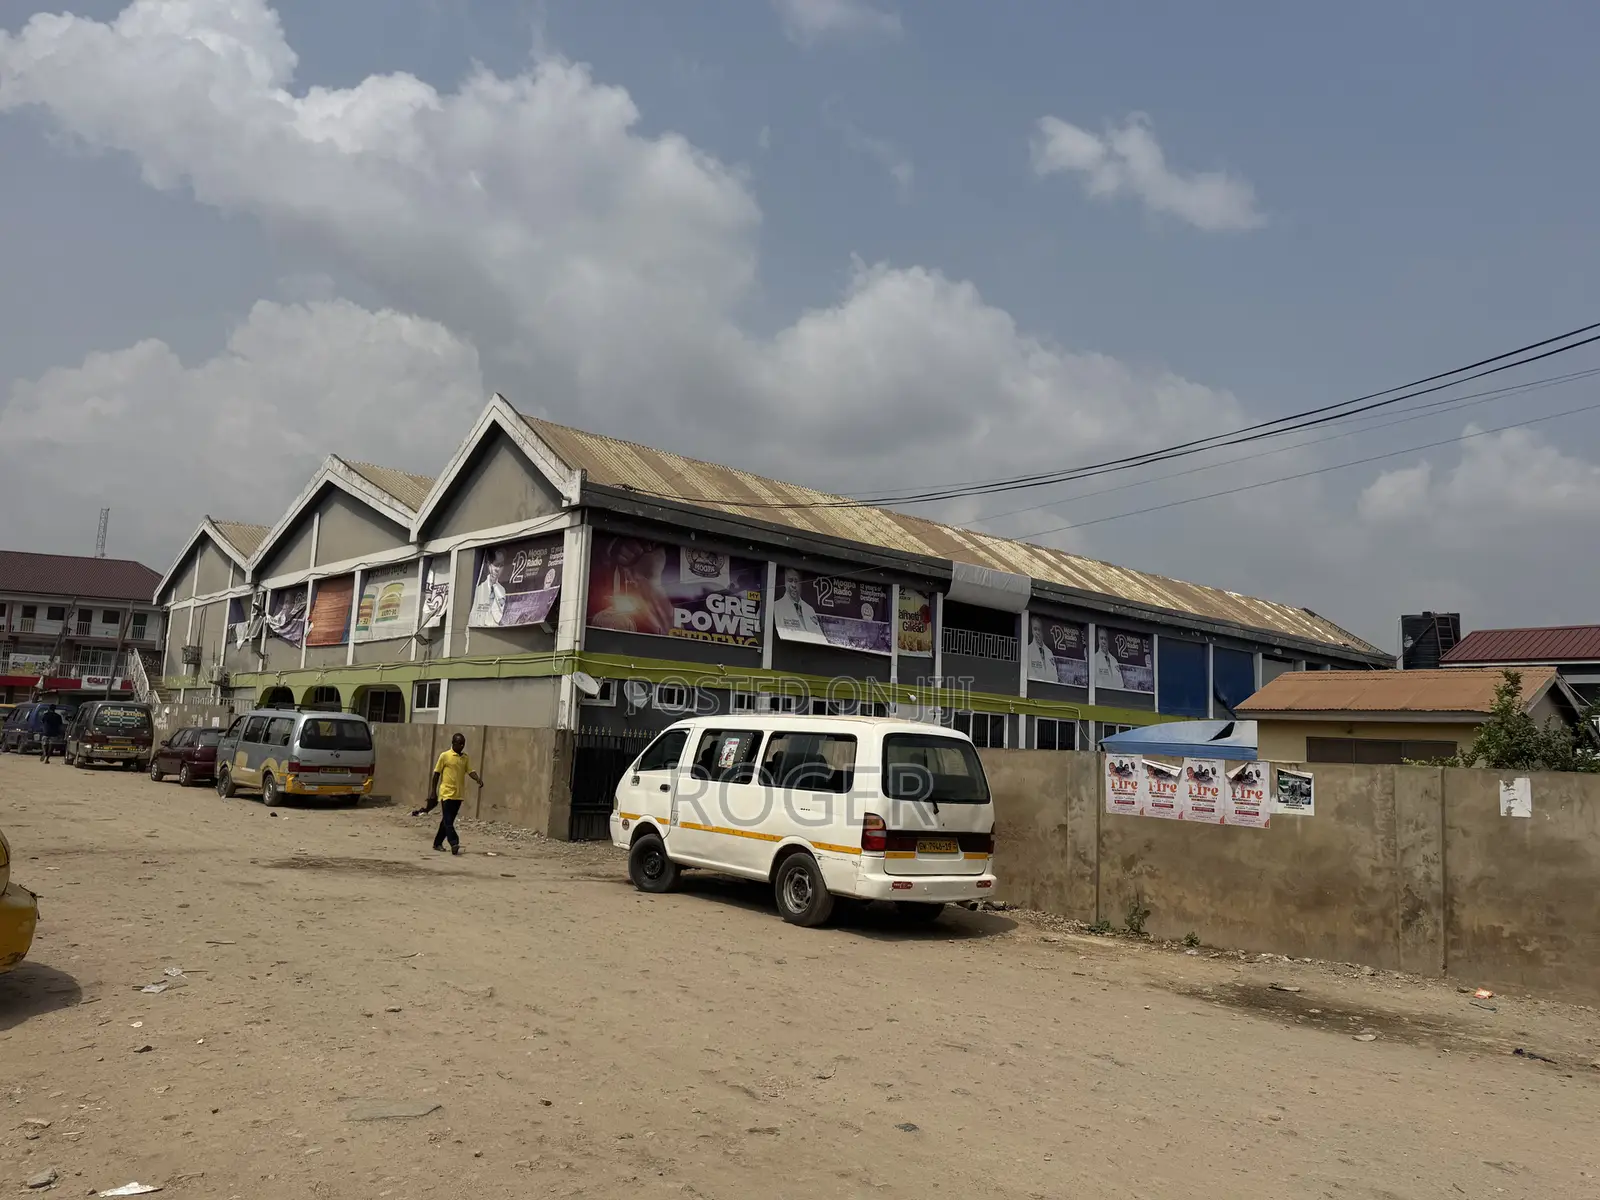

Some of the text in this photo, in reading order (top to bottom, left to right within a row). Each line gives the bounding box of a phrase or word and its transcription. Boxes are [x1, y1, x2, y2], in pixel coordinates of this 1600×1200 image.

[833, 587, 852, 597] Radio
[1111, 777, 1138, 790] Fire
[1148, 779, 1178, 792] Fire
[1188, 782, 1219, 796] Fire
[1231, 785, 1264, 799] Fire
